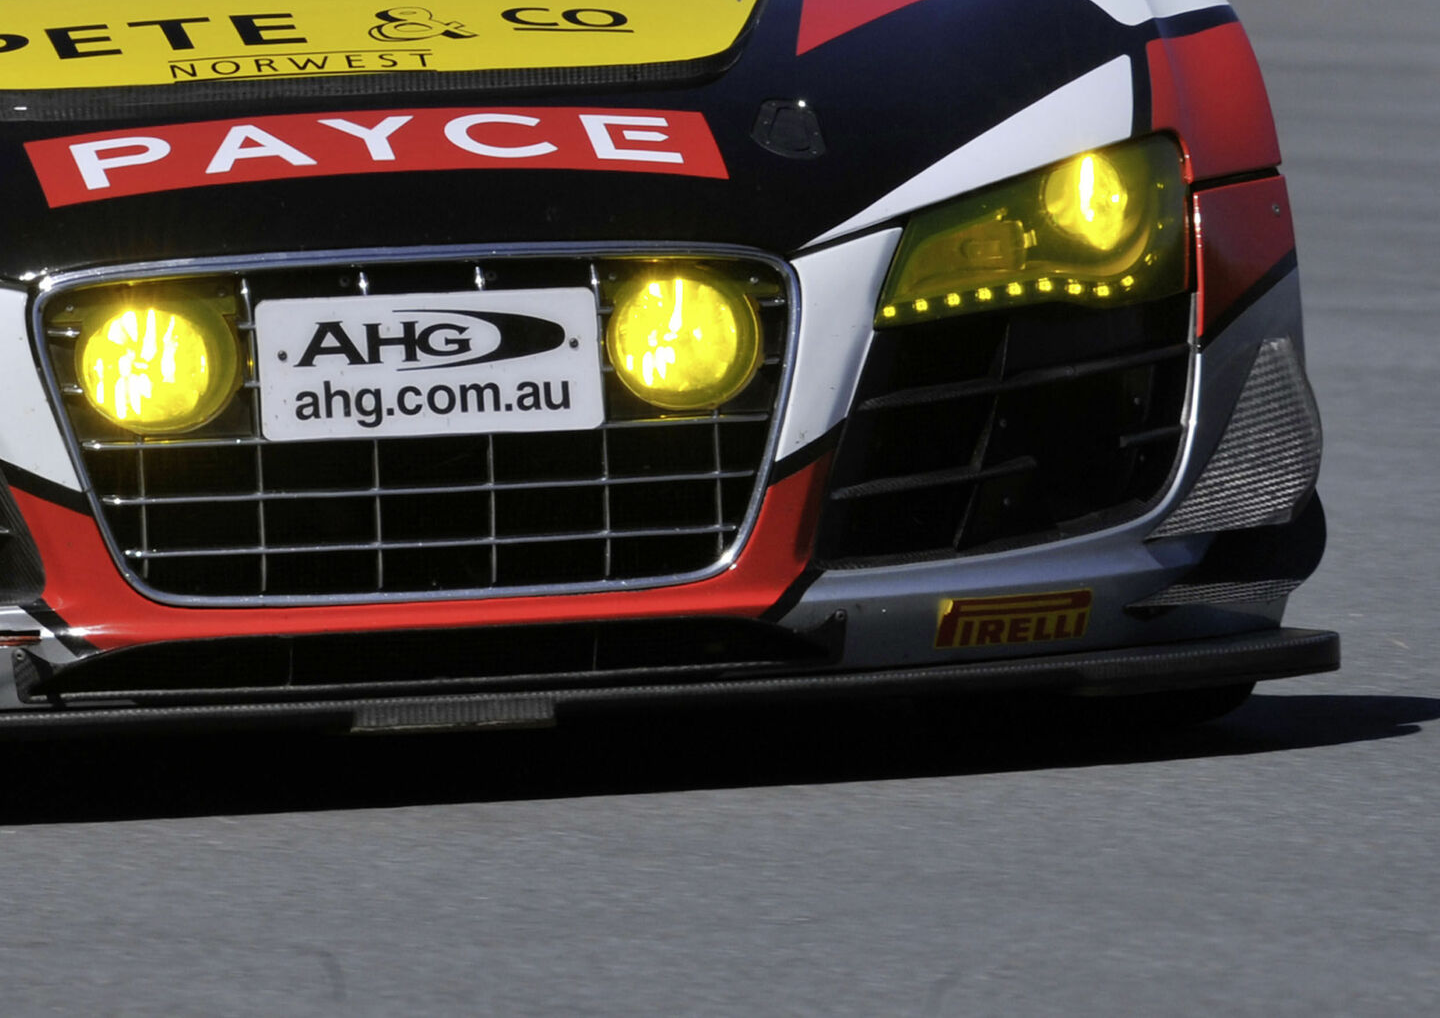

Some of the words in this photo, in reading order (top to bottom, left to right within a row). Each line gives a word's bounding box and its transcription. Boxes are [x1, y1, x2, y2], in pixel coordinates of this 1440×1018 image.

[368, 6, 478, 42] &
[500, 7, 630, 32] CO
[169, 52, 434, 79] NORWEST
[67, 113, 685, 190] PAYCE
[294, 319, 474, 368] AHG
[294, 379, 572, 428] ahg.com.au
[934, 589, 1094, 649] PIRELLI
